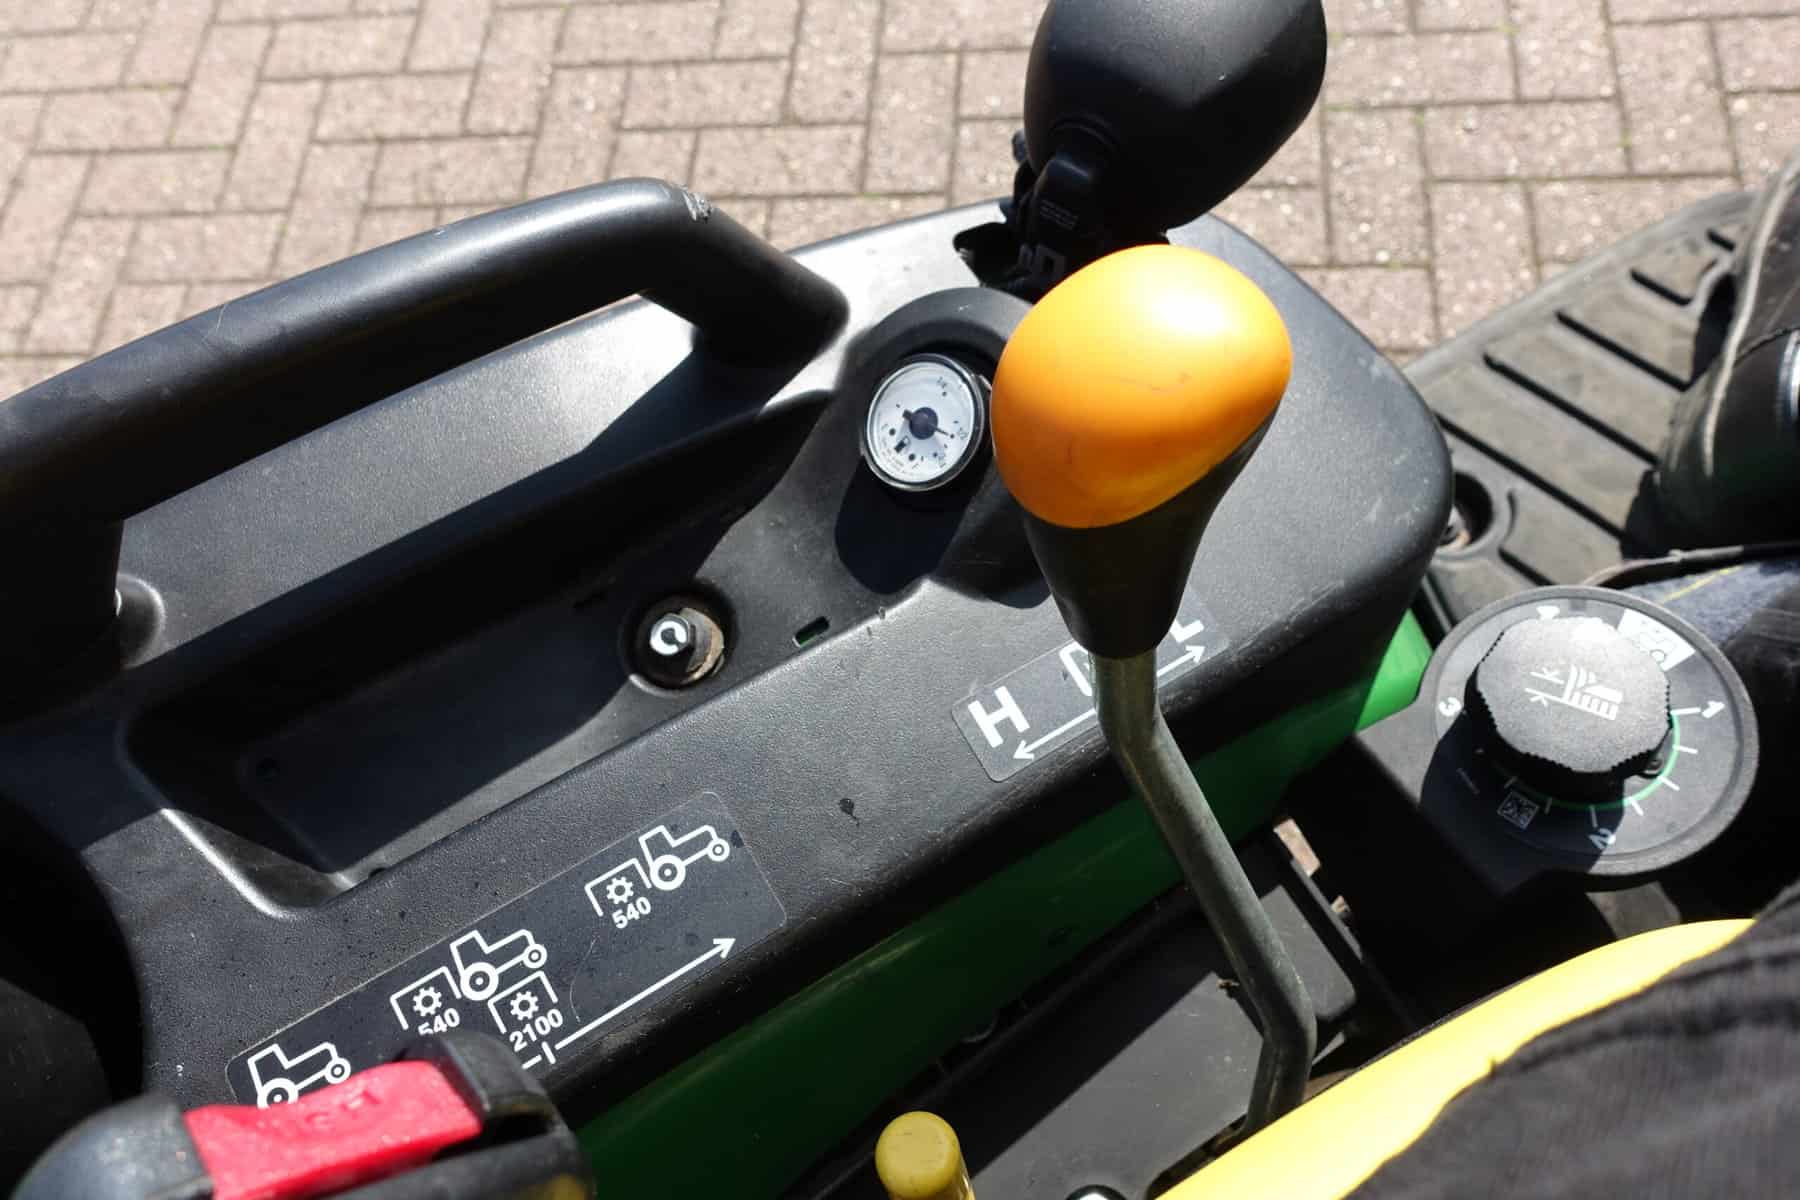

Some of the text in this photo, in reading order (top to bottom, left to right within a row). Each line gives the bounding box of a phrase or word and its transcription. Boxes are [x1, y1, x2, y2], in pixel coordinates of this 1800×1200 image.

[967, 685, 1030, 748] H
[611, 896, 652, 929] 540
[417, 1008, 460, 1036] 540
[509, 1008, 563, 1052] 2100
